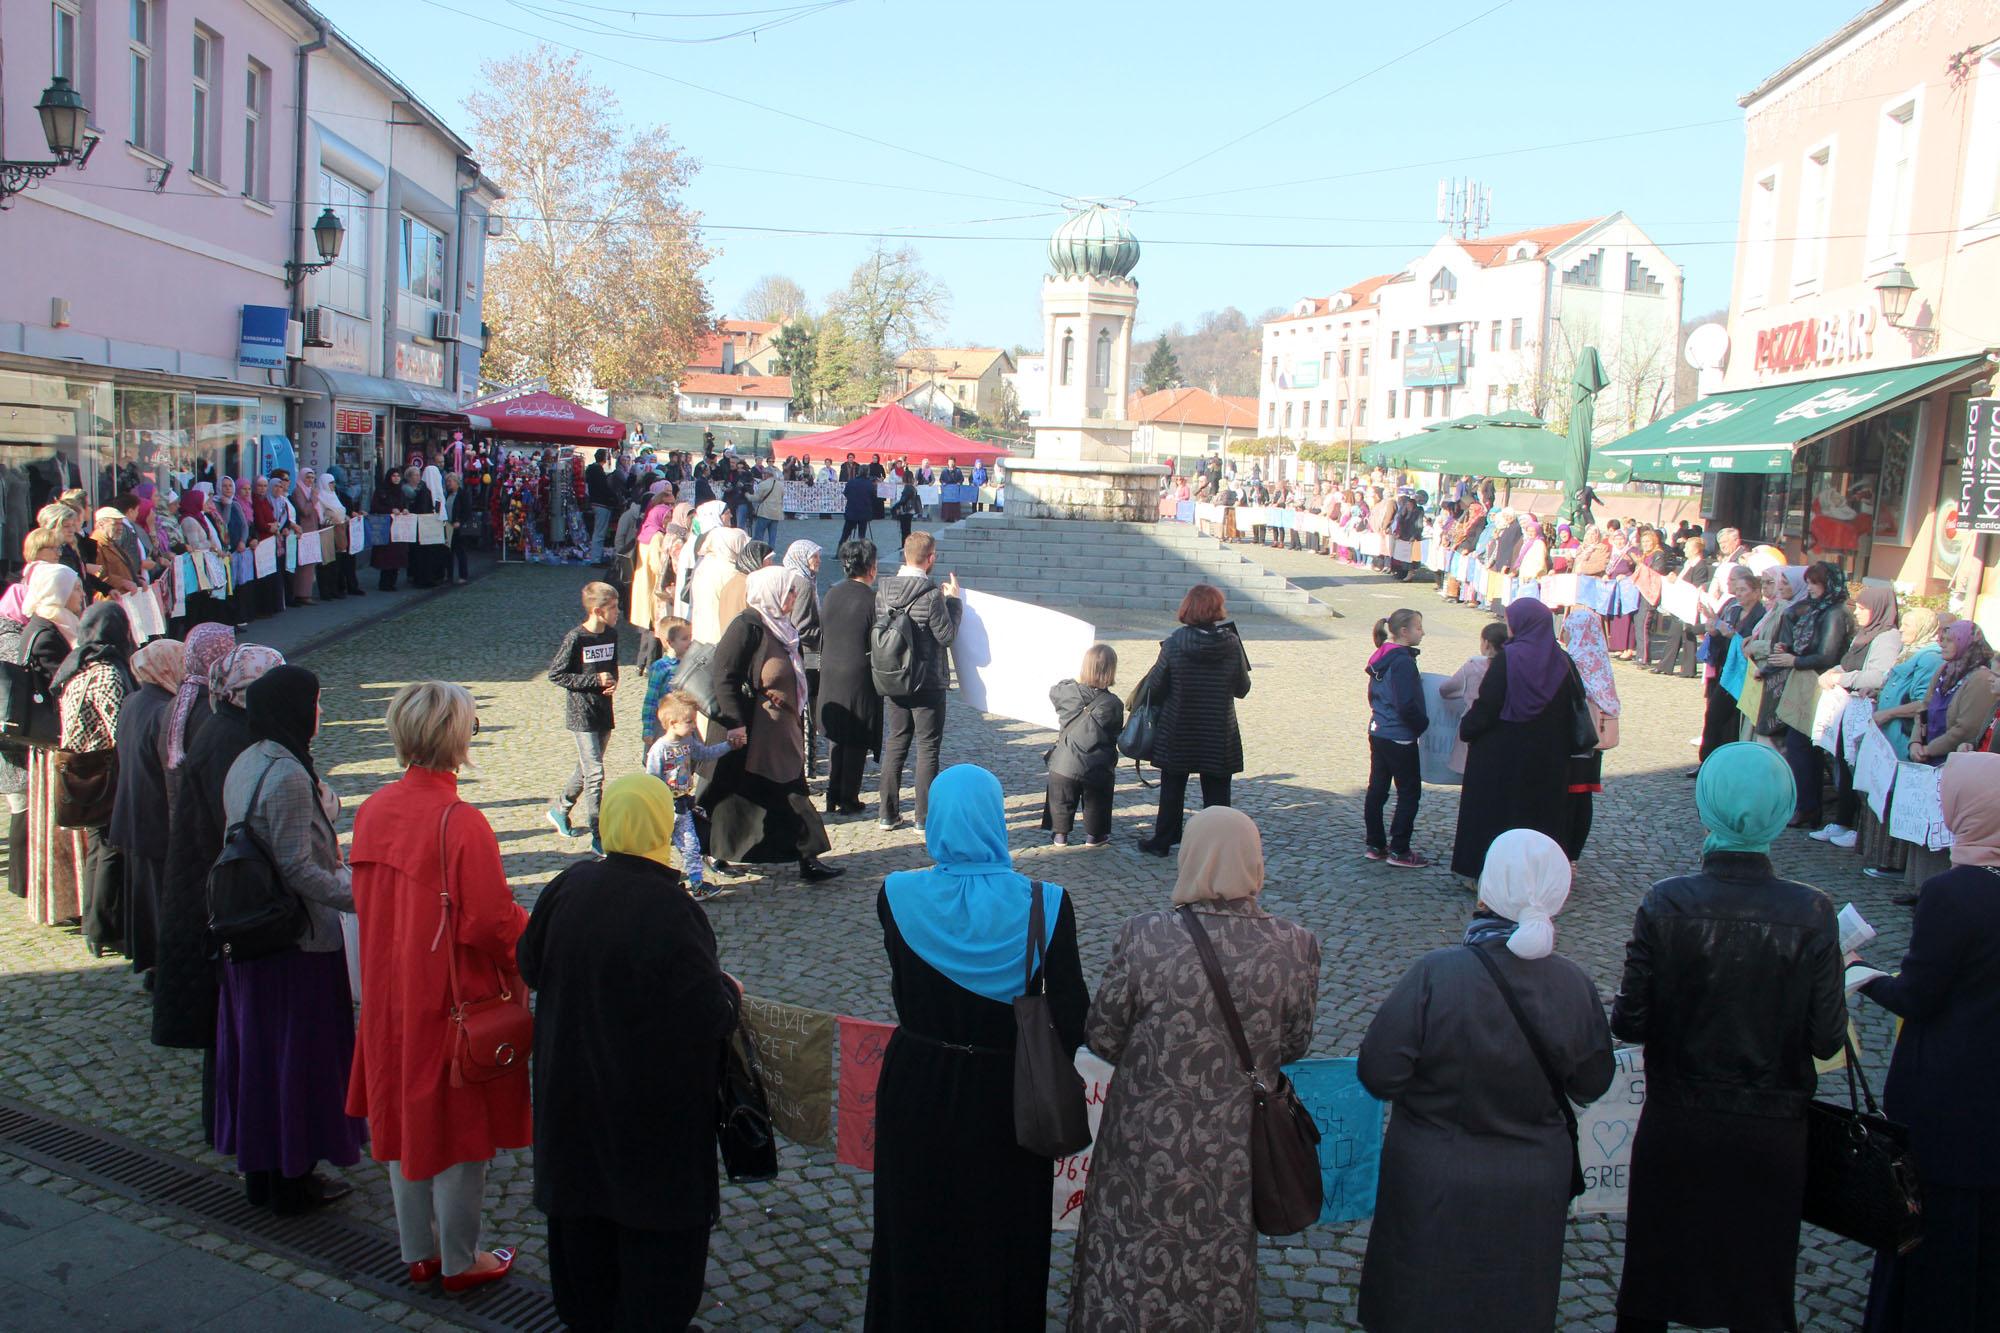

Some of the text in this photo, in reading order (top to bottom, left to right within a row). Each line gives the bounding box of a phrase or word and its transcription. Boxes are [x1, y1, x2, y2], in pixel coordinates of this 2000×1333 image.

[1753, 317, 1817, 371] PIZZA
[1957, 404, 1980, 517] knjižara
[585, 647, 604, 660] EASY
